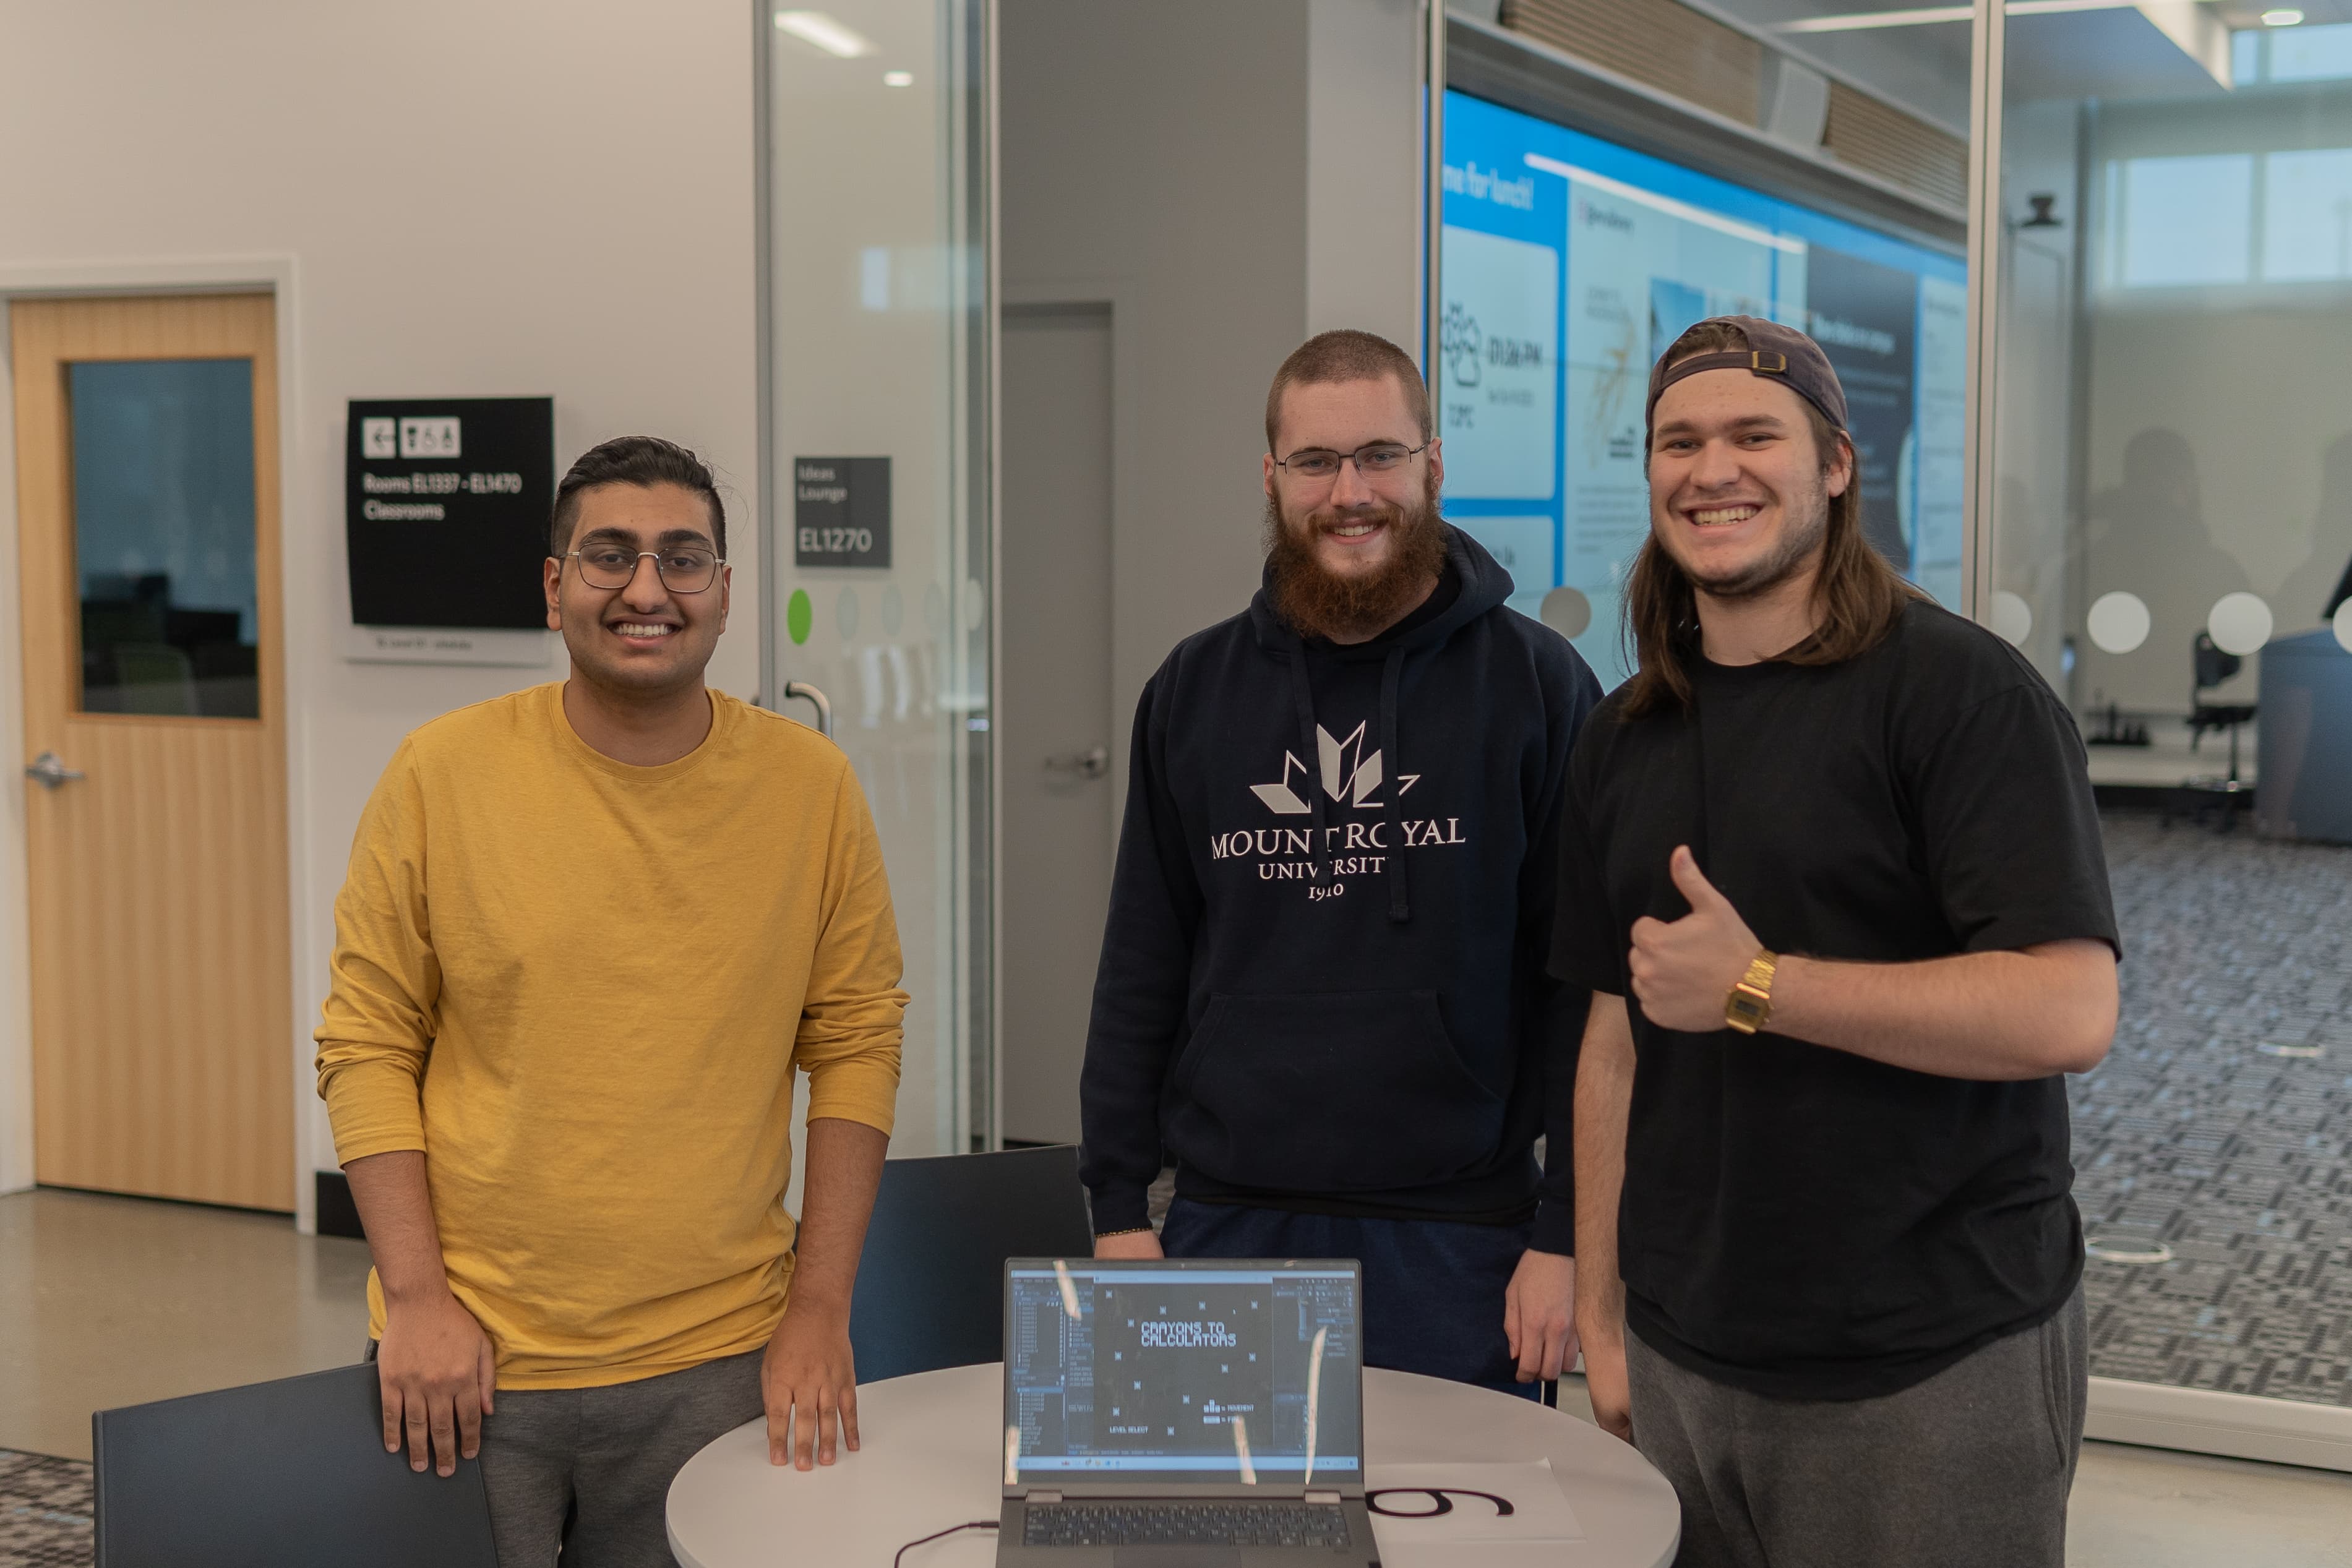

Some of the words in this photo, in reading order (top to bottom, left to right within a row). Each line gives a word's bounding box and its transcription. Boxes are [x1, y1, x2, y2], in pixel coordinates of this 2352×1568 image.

[799, 465, 835, 482] Ideas
[364, 473, 411, 494] Rooms
[412, 473, 460, 494] EL1337
[470, 472, 523, 494] EL1470
[799, 485, 848, 504] Lounge
[364, 499, 445, 520] Classrooms
[799, 528, 873, 552] EL1270
[1258, 856, 1389, 880] UNIVRSIT
[1308, 883, 1344, 901] 1910
[1207, 1321, 1225, 1335] TO
[1141, 1333, 1237, 1347] CALCULATORS
[1110, 1425, 1127, 1434] LEVEL
[1128, 1425, 1149, 1434] SELECT
